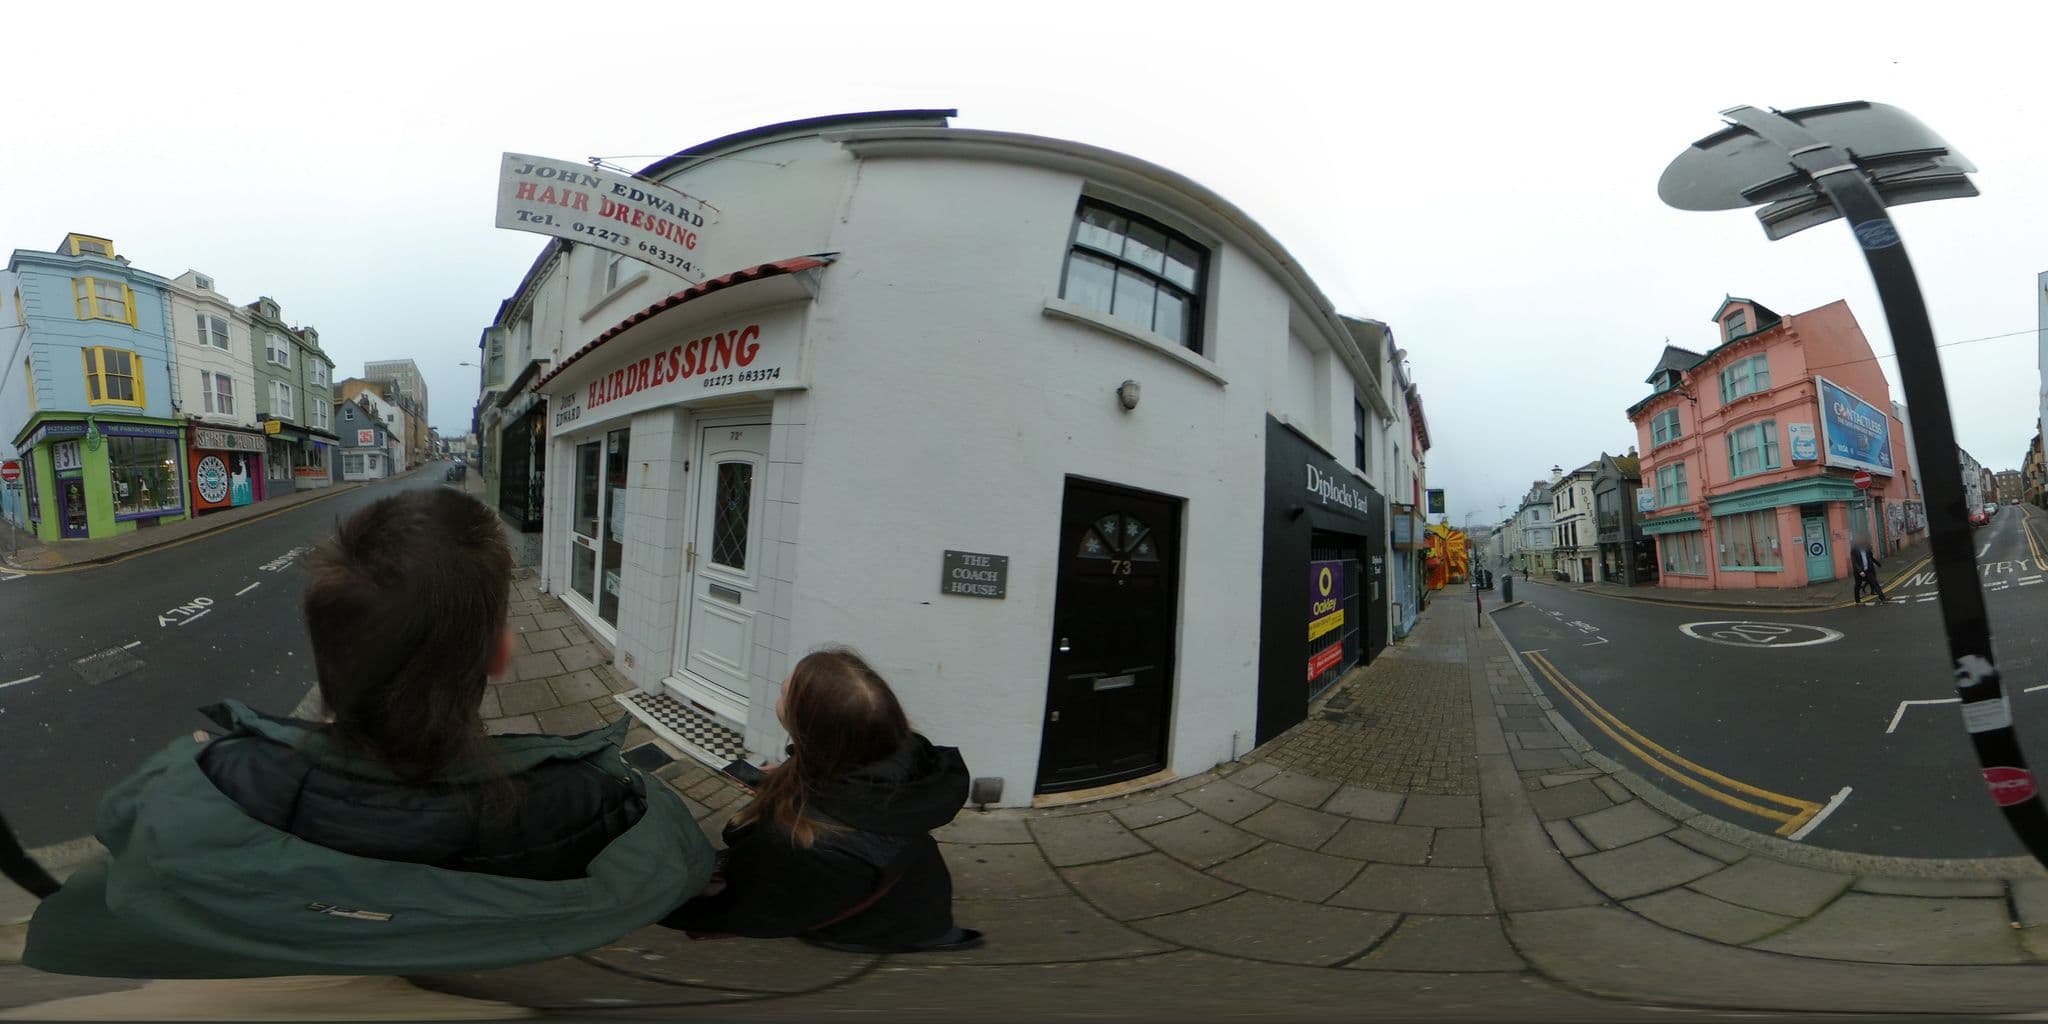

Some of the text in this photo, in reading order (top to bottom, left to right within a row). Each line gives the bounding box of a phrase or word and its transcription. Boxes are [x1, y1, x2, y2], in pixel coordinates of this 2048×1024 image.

[514, 163, 704, 228] JOHN EDWARD
[515, 181, 697, 250] HAIR DRESSING
[516, 210, 560, 228] Tel.
[572, 222, 630, 246] 01273
[587, 324, 761, 410] HAIRDRESSING
[703, 366, 781, 388] 01273 683374
[559, 391, 577, 411] JOHN
[555, 405, 582, 428] EDWARD
[1306, 463, 1368, 513] Diplocks Yard
[962, 554, 990, 567] THE
[1111, 560, 1132, 575] 73
[952, 568, 998, 582] COACH
[952, 582, 997, 596] HOUSE
[158, 597, 214, 627] ONLY
[1313, 598, 1337, 615] Oakley
[1712, 625, 1792, 643] 20
